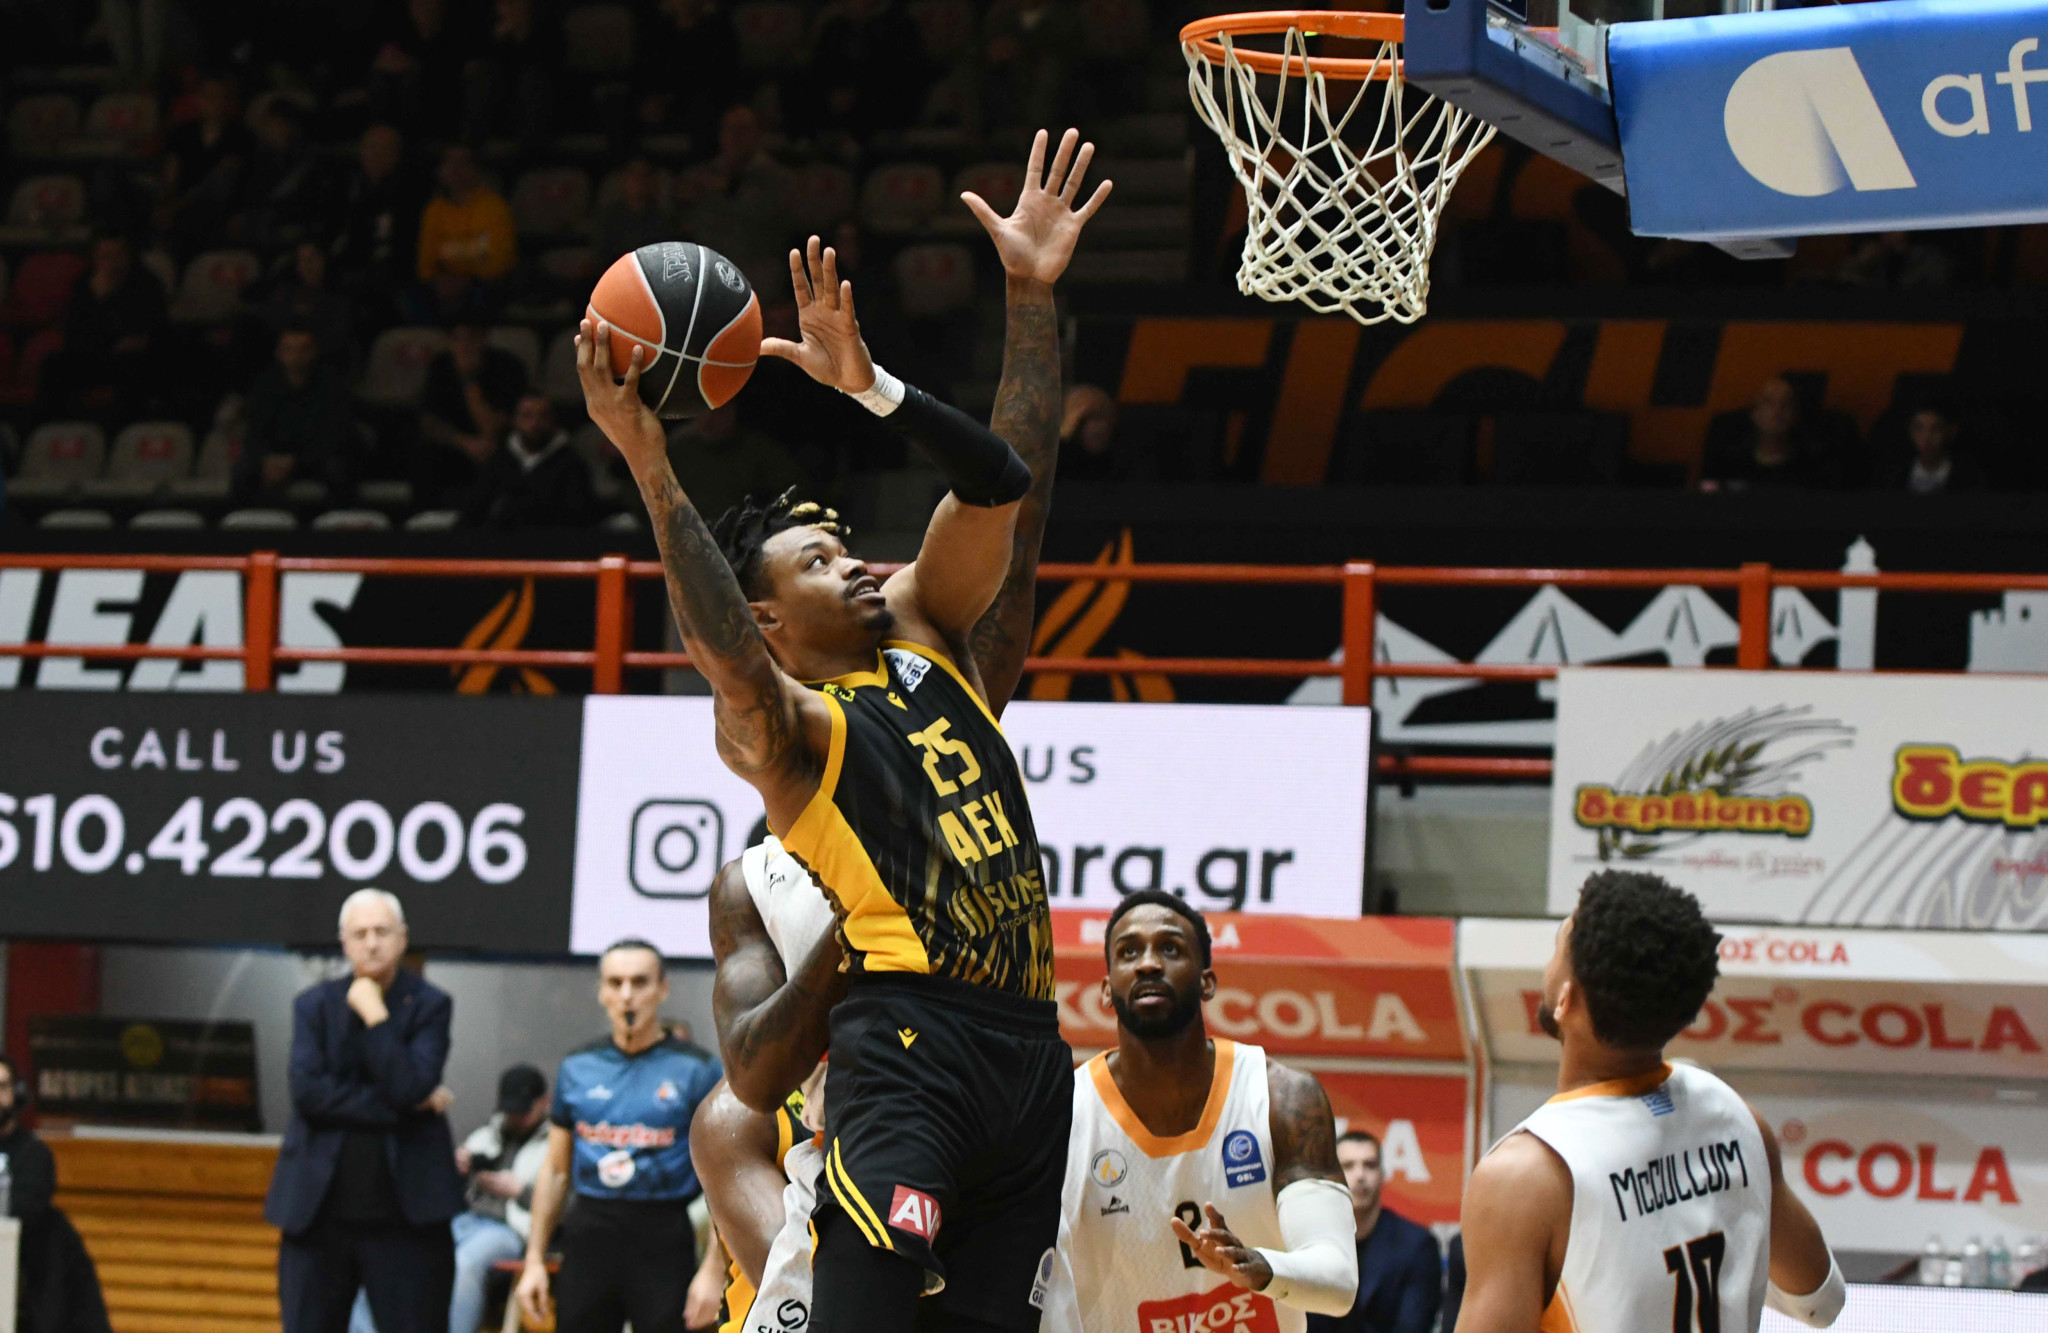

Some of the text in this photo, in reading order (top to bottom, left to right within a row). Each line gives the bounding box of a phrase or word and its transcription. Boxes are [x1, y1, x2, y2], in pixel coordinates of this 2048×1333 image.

[903, 662, 927, 687] GBL
[90, 726, 346, 774] CALL US
[907, 716, 982, 797] 25
[1021, 745, 1096, 784] US
[938, 790, 1019, 867] AEK
[1767, 940, 1849, 964] COLA
[1203, 987, 1429, 1043] COLA
[1802, 1002, 2042, 1054] COLA
[1803, 1139, 2021, 1205] COLA
